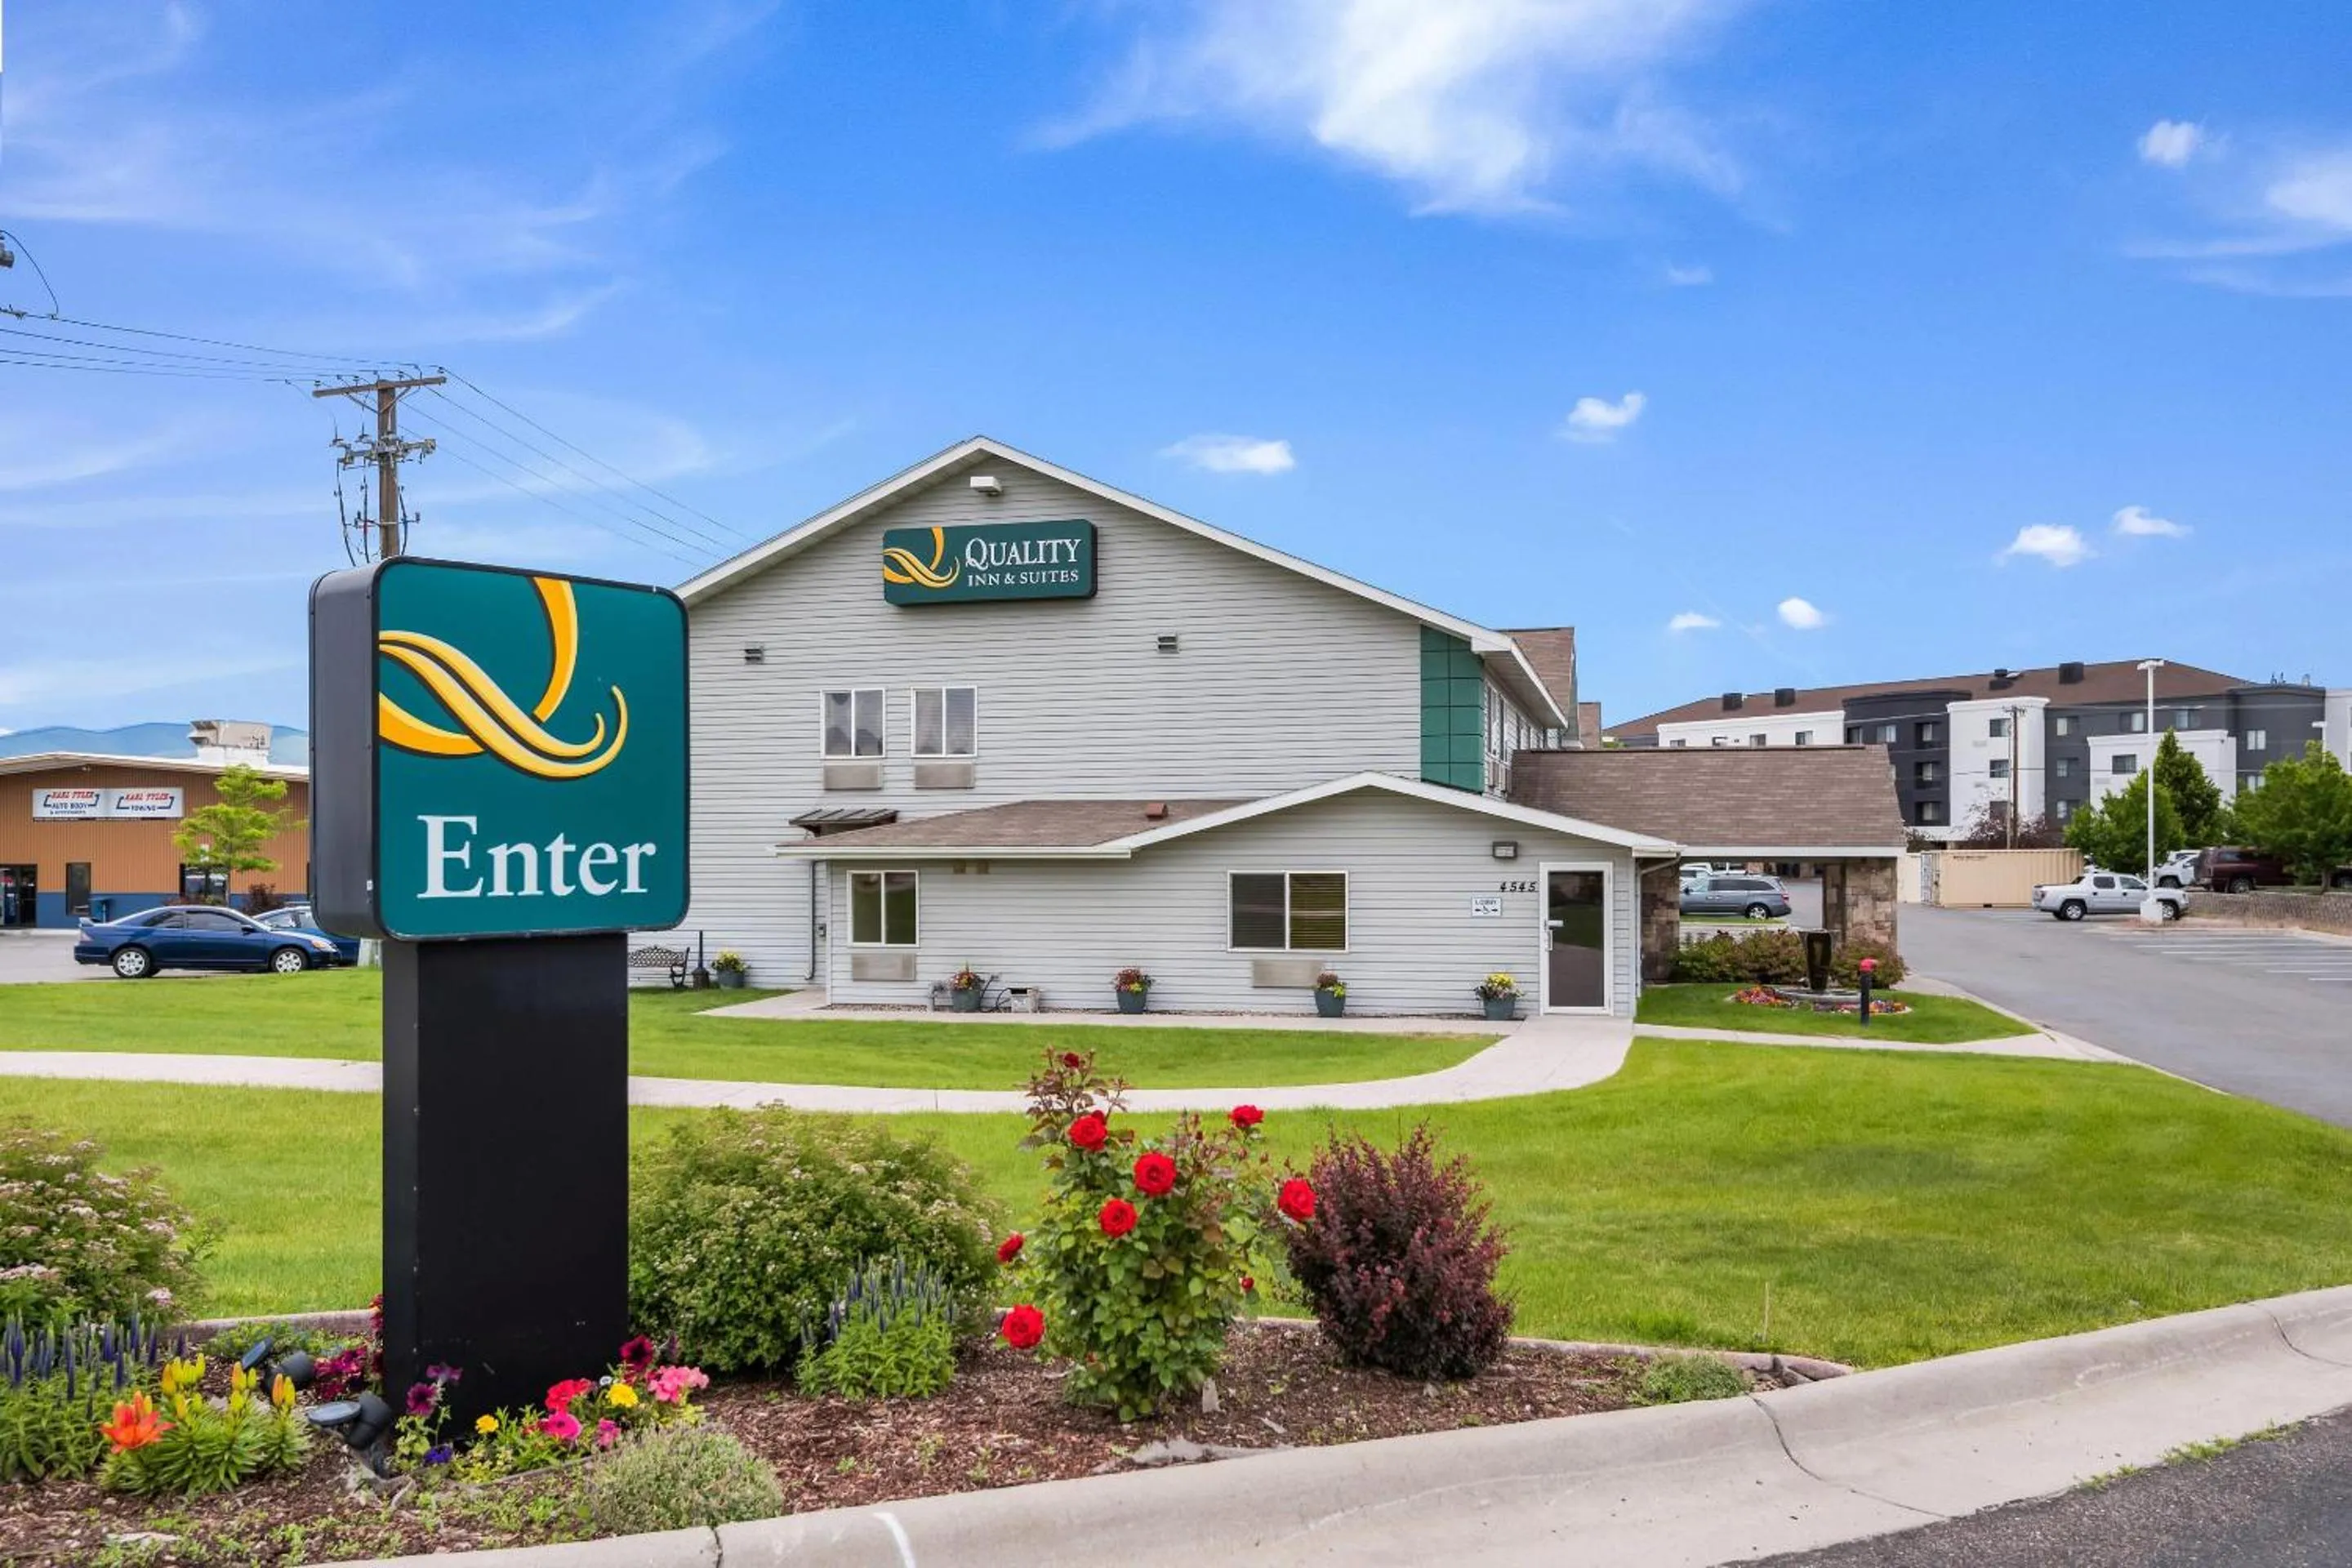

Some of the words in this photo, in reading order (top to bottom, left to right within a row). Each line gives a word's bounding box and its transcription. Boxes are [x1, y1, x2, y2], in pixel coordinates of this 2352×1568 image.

[965, 537, 1081, 571] QUALITY
[968, 573, 1000, 587] INN
[1004, 573, 1016, 585] &
[1020, 569, 1080, 585] SUITES
[416, 814, 657, 899] Enter
[1500, 881, 1537, 893] 4545
